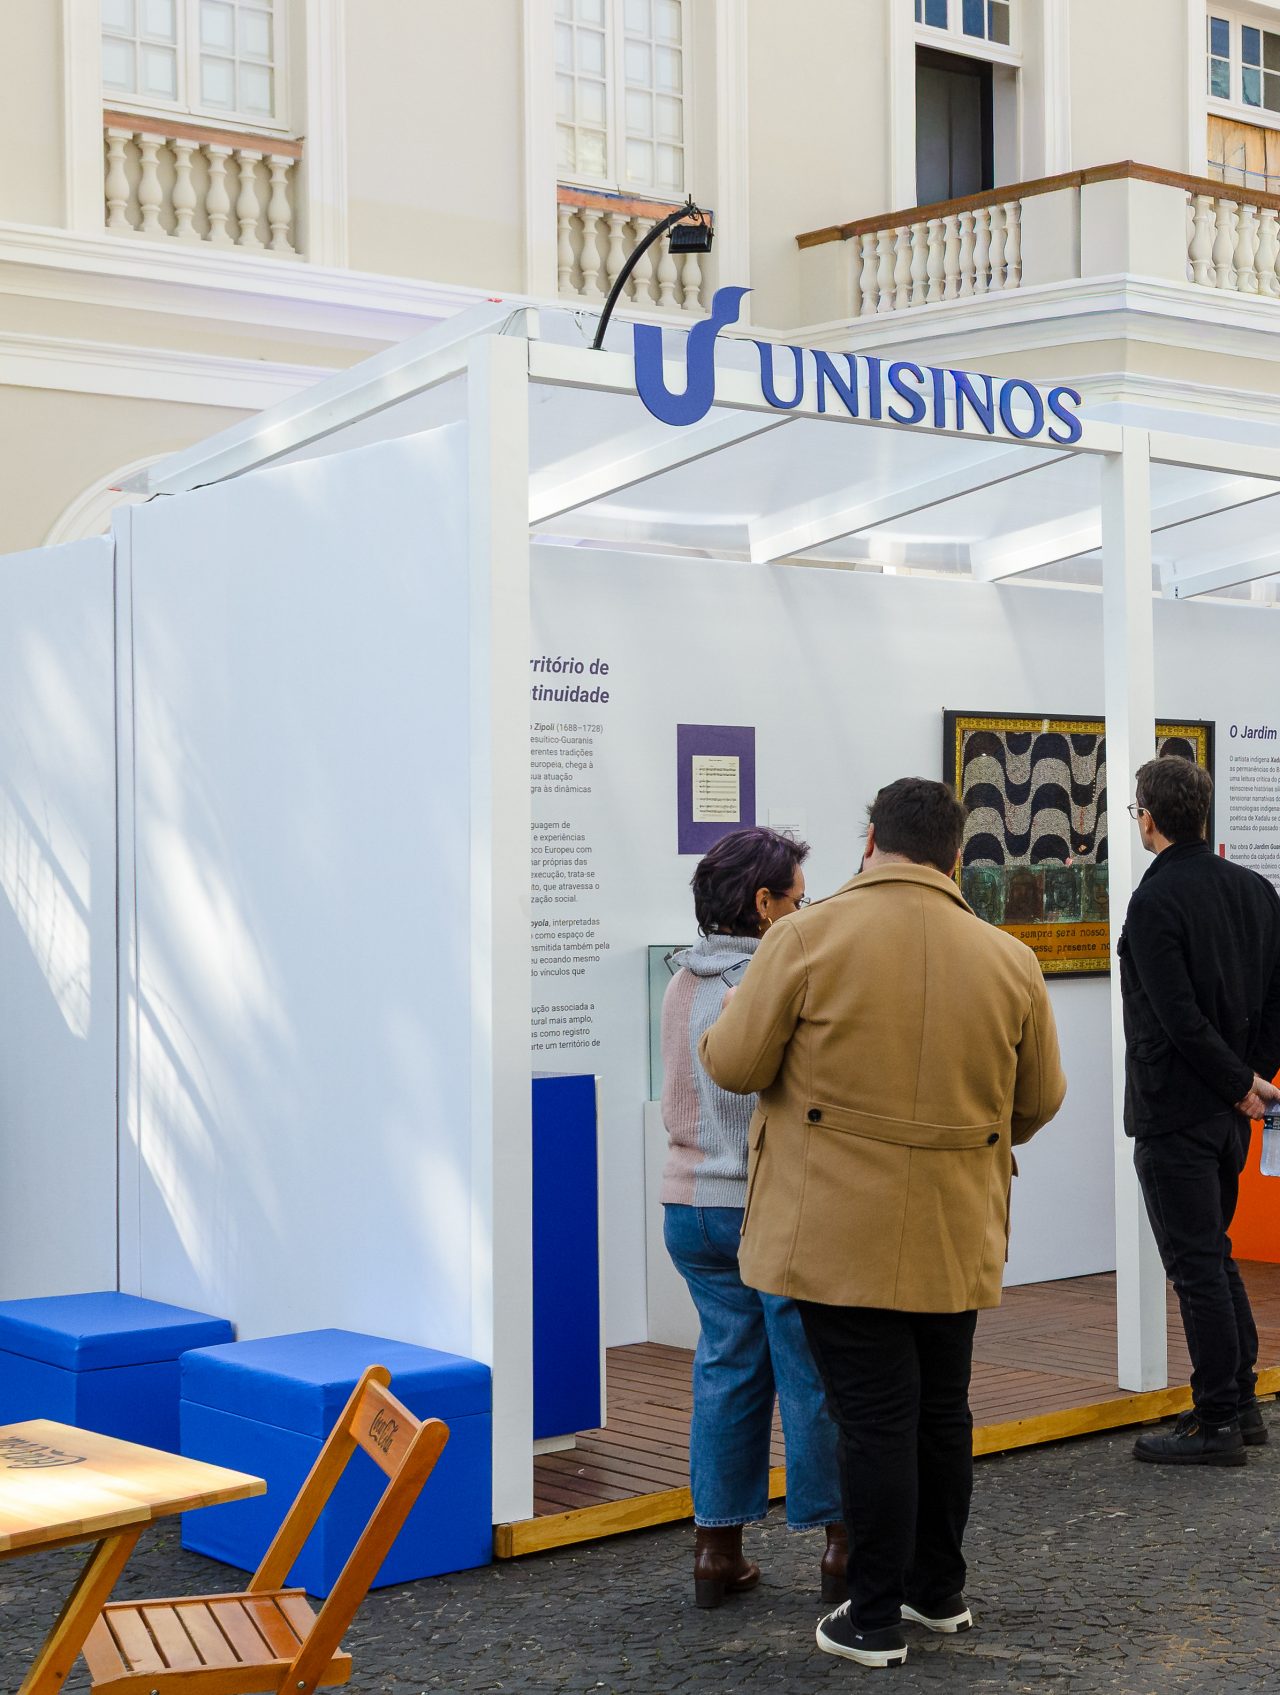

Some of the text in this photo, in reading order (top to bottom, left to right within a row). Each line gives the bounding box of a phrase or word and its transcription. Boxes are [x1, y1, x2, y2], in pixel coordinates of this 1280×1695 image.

[753, 340, 1083, 444] UNISINOS
[590, 659, 609, 675] de
[534, 723, 554, 731] Zipoli
[1230, 725, 1238, 738] O
[1241, 726, 1277, 739] Jardim
[560, 749, 593, 757] tradições
[565, 761, 587, 770] chega
[544, 773, 572, 782] atuação
[554, 785, 591, 793] dinâmicas
[562, 821, 570, 829] de
[540, 833, 585, 843] experiências
[545, 846, 574, 855] Europeu
[543, 858, 572, 867] próprias
[552, 918, 600, 928] interpretadas
[535, 931, 555, 940] como
[557, 931, 583, 940] espaço
[563, 942, 610, 951] também pela
[1057, 943, 1096, 954] presente
[540, 955, 571, 964] ecoando
[540, 968, 585, 976] vínculos que
[551, 1003, 588, 1012] associada
[549, 1016, 567, 1024] mais
[540, 1028, 590, 1037] como registro
[546, 1039, 600, 1050] um território de
